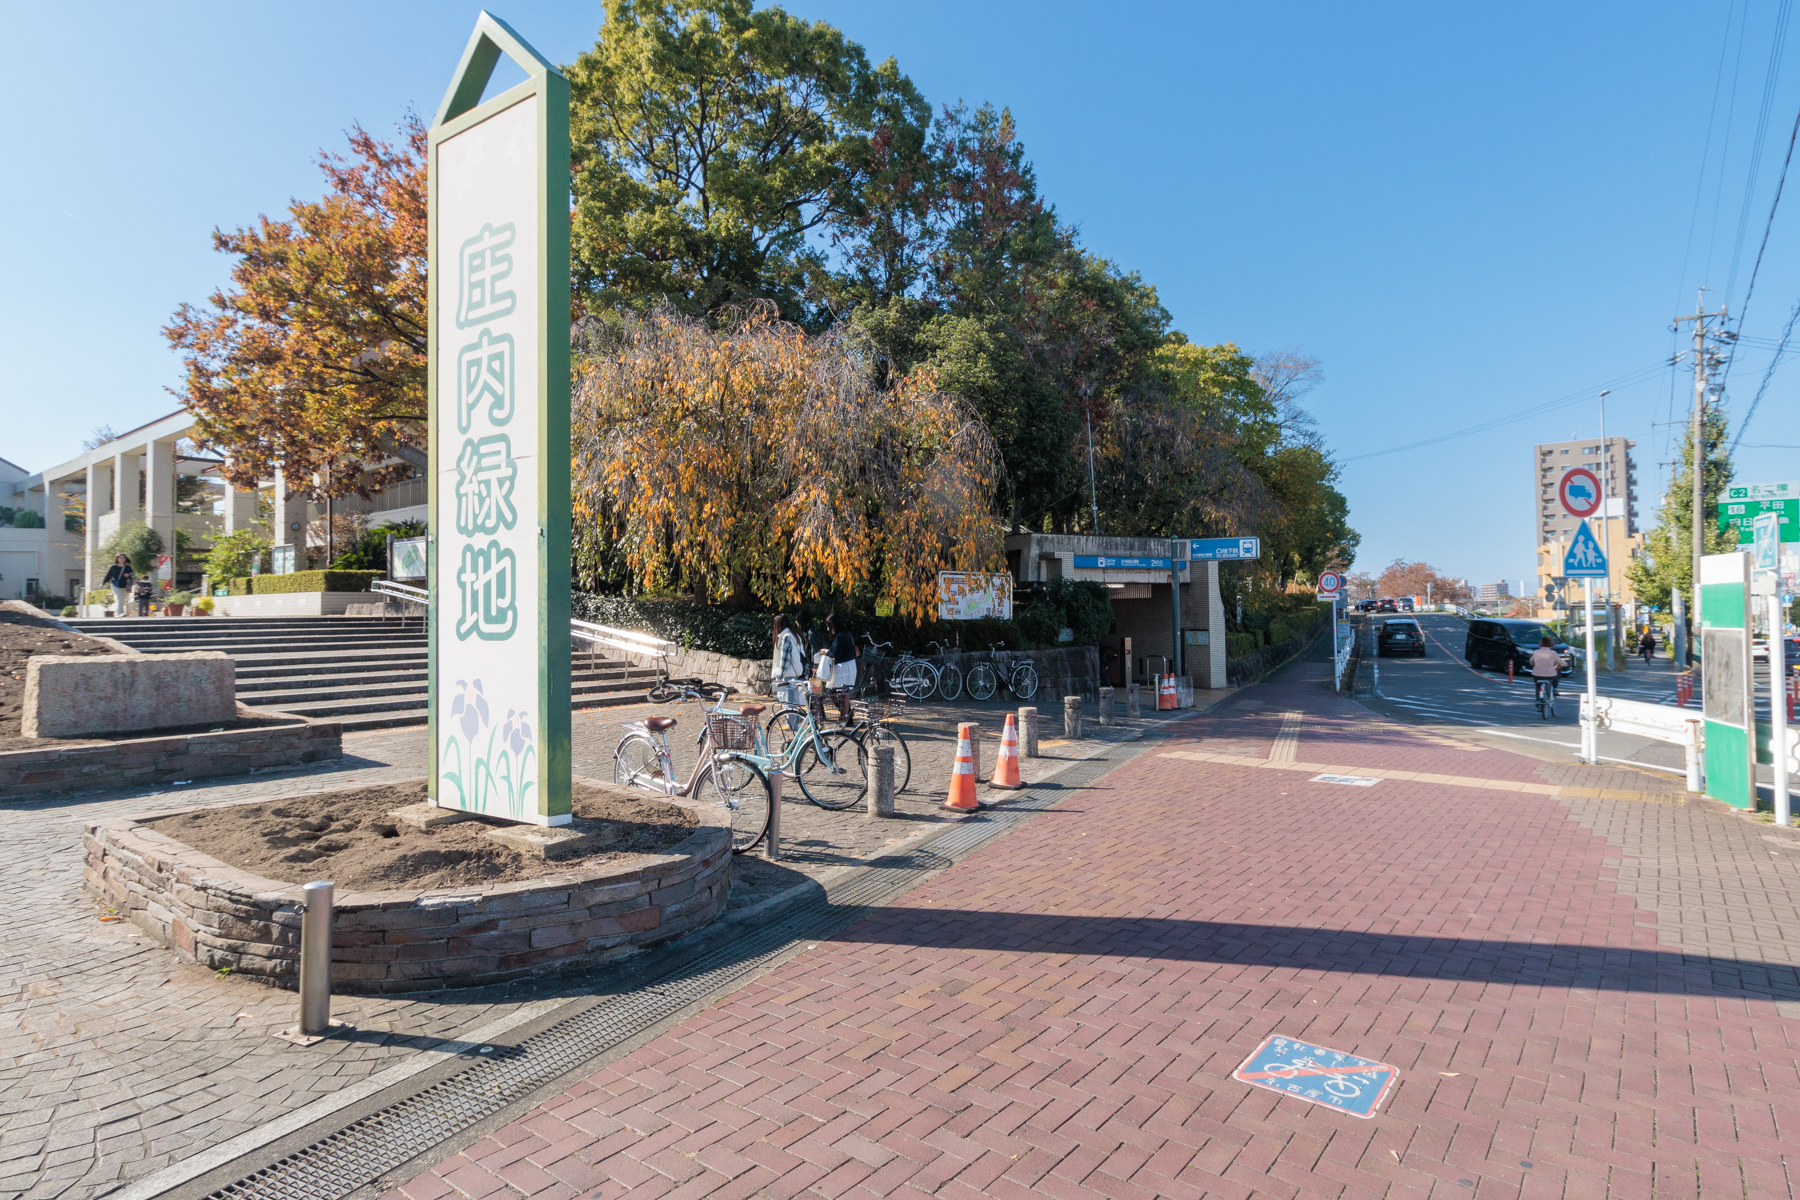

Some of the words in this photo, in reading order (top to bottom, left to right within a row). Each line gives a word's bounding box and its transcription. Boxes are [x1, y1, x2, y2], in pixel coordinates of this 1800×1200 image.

[455, 221, 518, 643] 庄内緑地
[1750, 483, 1789, 494] 名二環
[1730, 489, 1746, 498] C2
[1729, 505, 1744, 514] 16
[1759, 501, 1785, 510] 平田
[1323, 577, 1336, 587] 40
